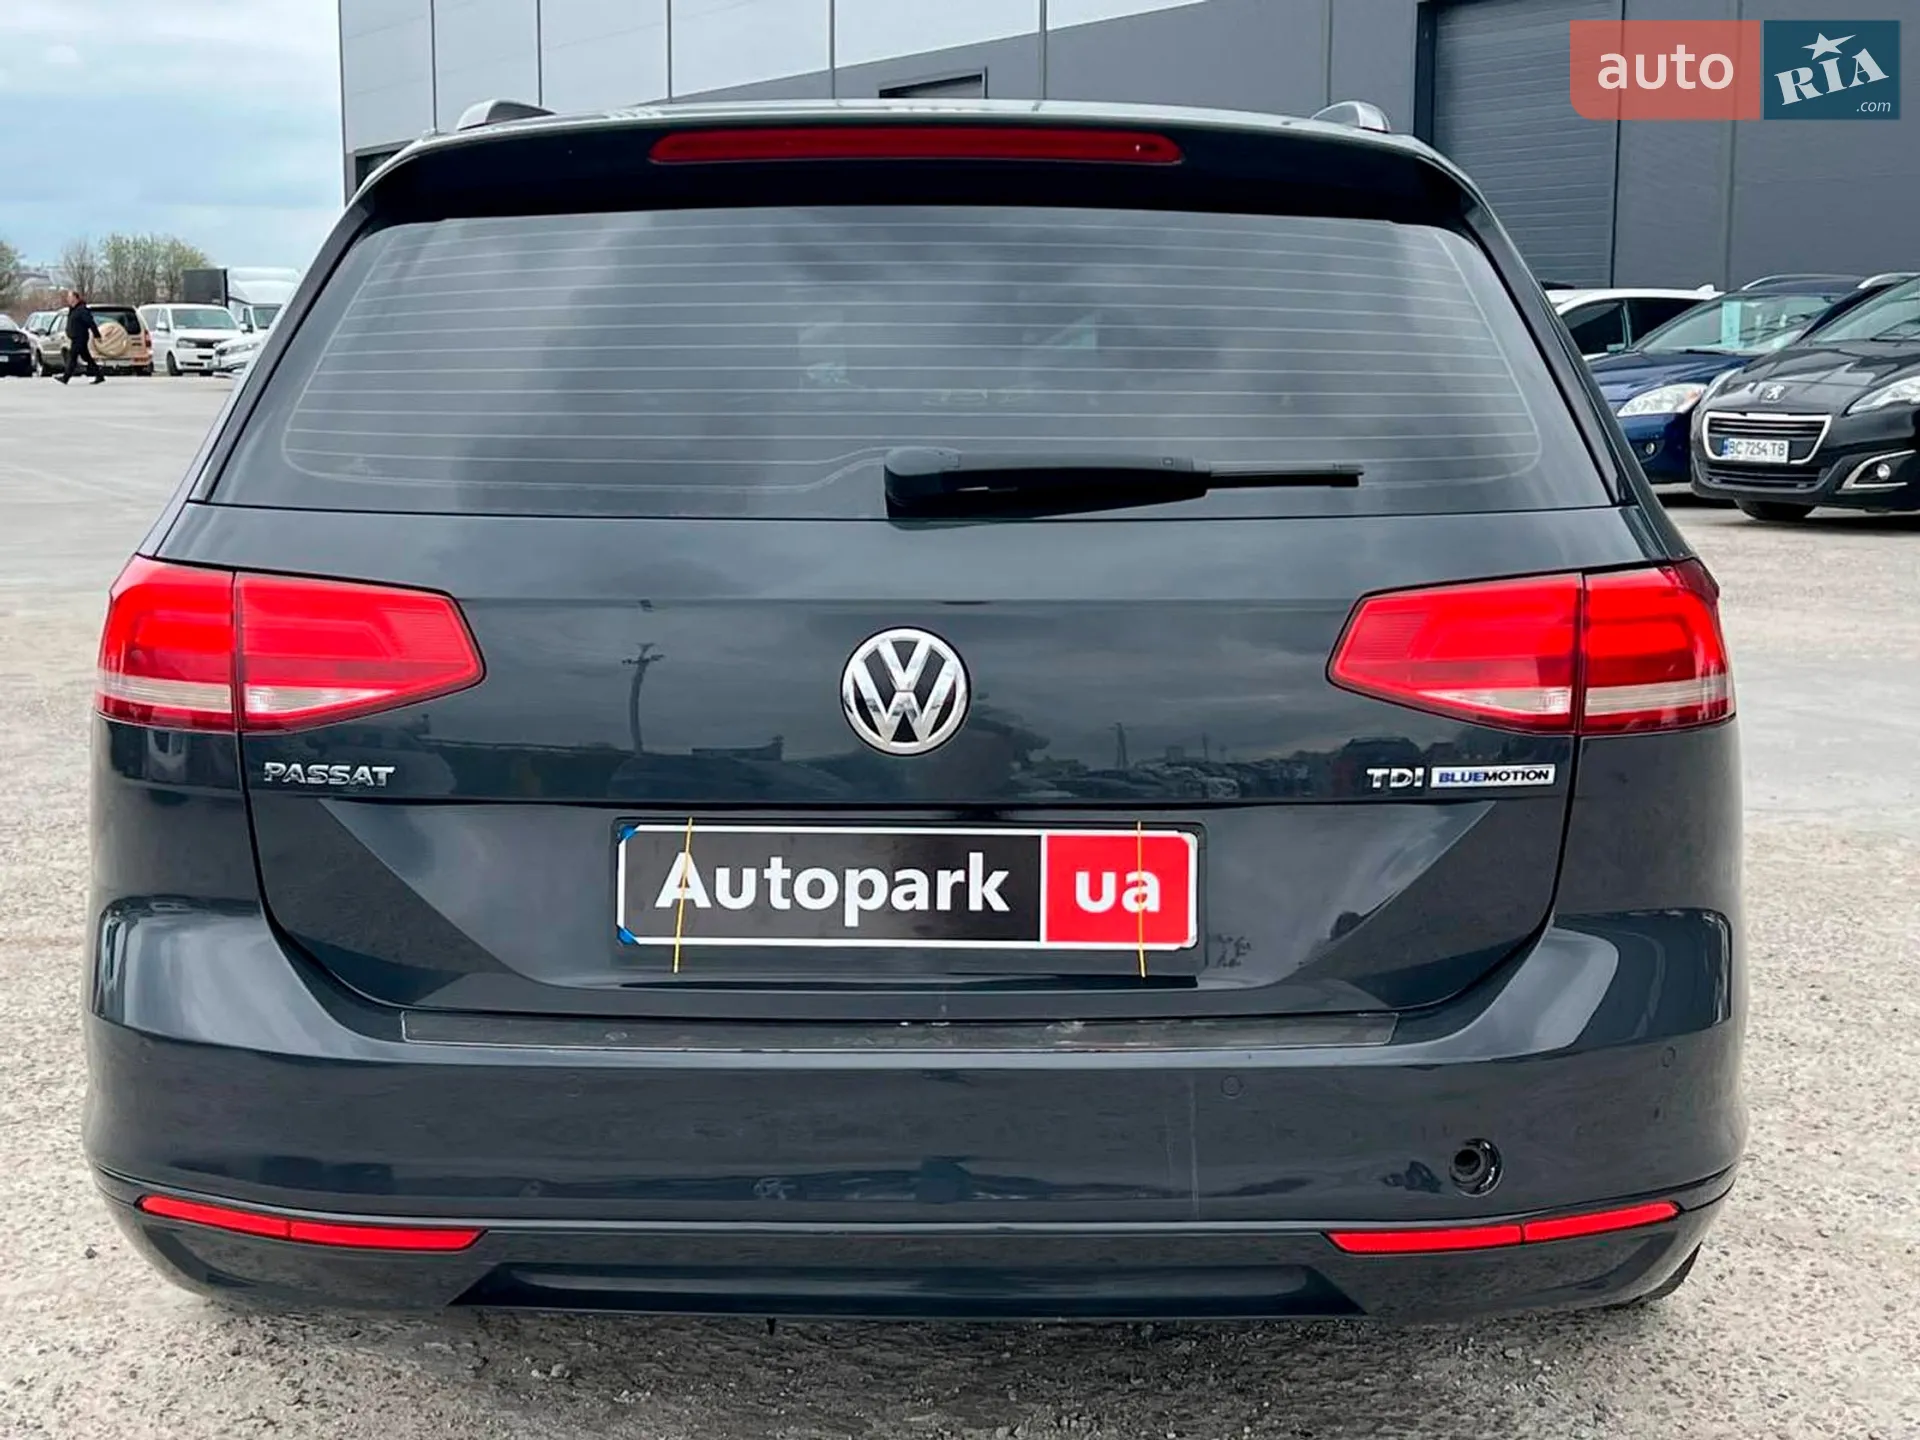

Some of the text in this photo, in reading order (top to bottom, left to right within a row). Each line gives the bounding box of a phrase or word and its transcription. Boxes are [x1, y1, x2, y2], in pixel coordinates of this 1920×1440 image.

[1729, 440, 1743, 455] BC
[263, 761, 396, 787] PASSAT
[1366, 767, 1550, 789] TDI BLUEMOTION
[654, 851, 1161, 928] Autopark ua
